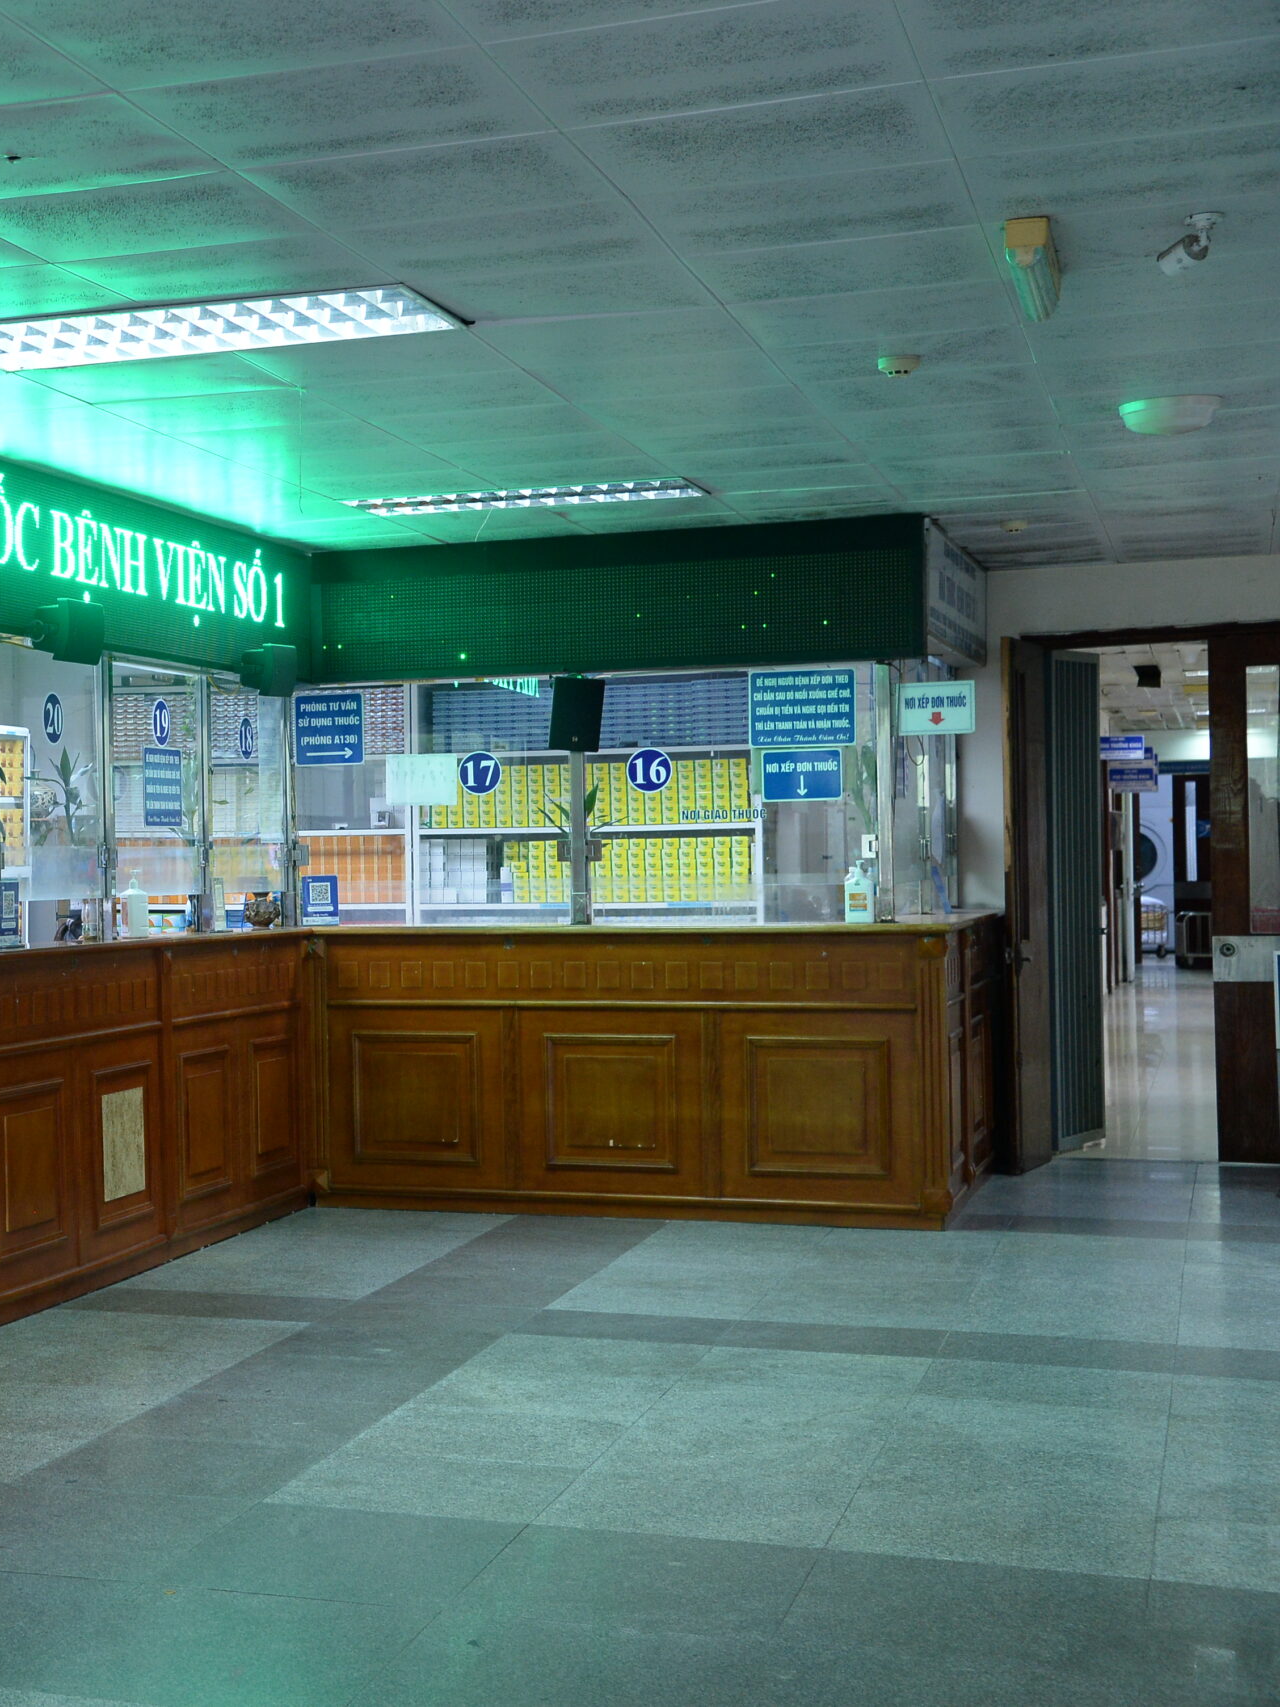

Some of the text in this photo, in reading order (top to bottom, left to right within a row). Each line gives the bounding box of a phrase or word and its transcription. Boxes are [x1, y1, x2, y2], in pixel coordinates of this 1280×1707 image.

[50, 510, 149, 604] BỆNH
[153, 541, 228, 627] VIỆN
[233, 548, 269, 628] SỐ
[272, 572, 287, 628] 1
[301, 699, 357, 712] PHÒNG TƯ VẤN
[905, 690, 966, 710] NƠI XẾP ĐƠN THUỐC
[46, 702, 62, 735] 20
[155, 708, 169, 737] 19
[298, 713, 359, 728] SỬ DỤNG THUỐC
[242, 725, 252, 752] 18
[301, 734, 357, 746] (PHÒNG A130)
[463, 760, 495, 787] 17
[632, 757, 667, 785] 16
[766, 758, 838, 773] NƠI XẾP ĐƠN THUỐC
[682, 809, 700, 820] NƠI
[704, 809, 728, 820] GIAO
